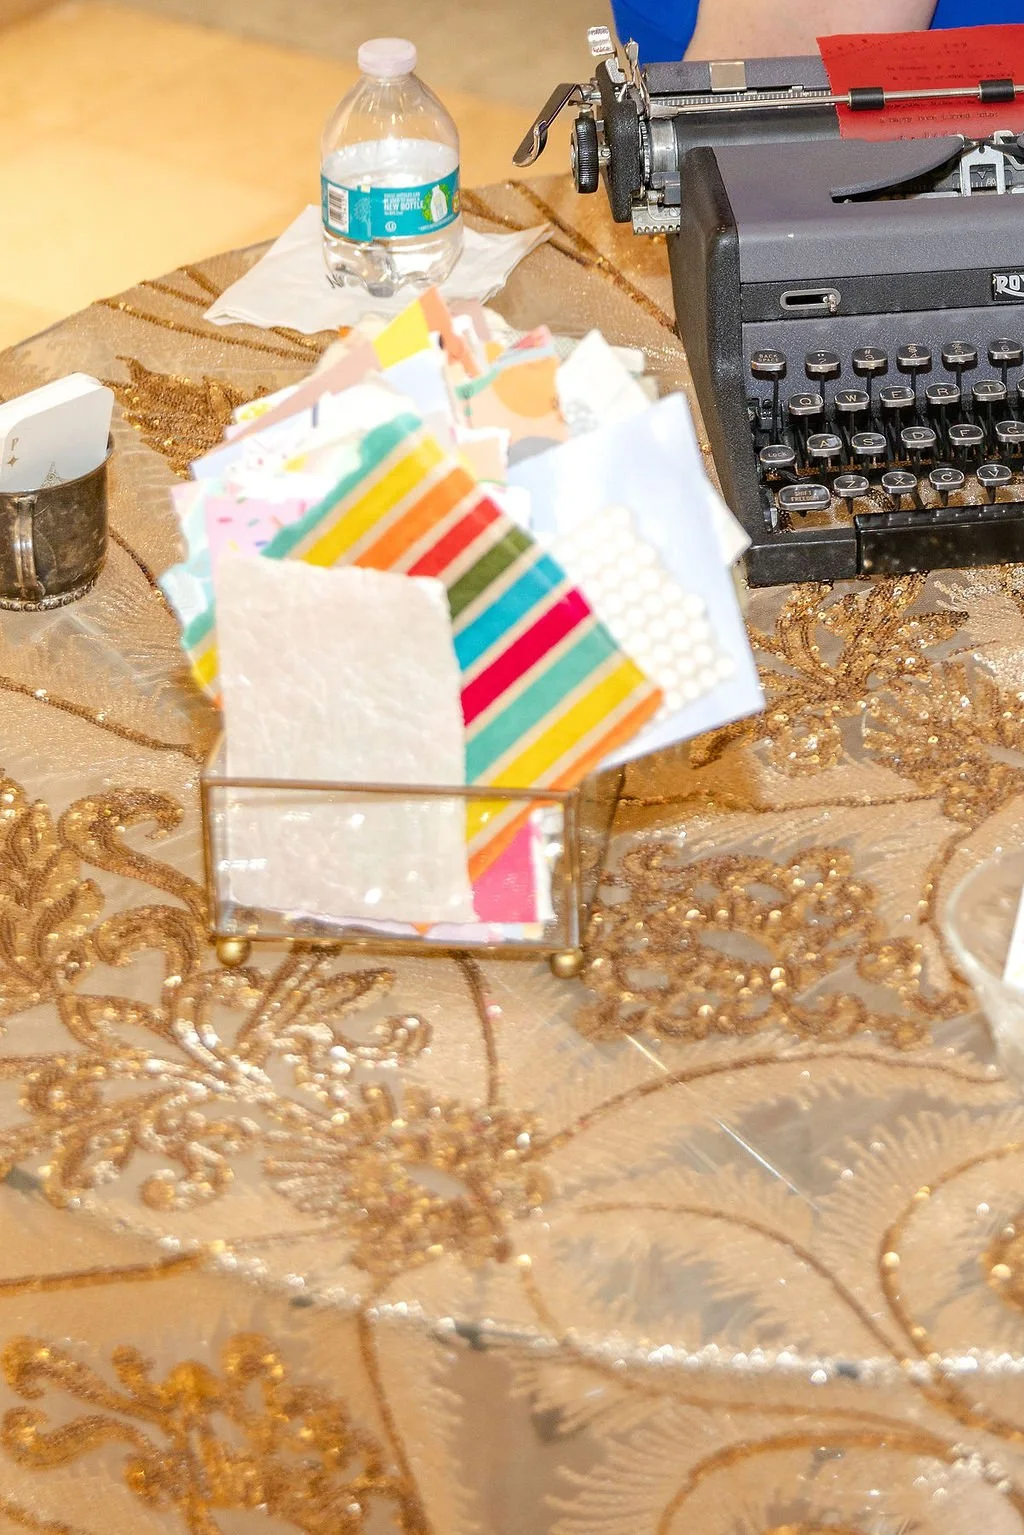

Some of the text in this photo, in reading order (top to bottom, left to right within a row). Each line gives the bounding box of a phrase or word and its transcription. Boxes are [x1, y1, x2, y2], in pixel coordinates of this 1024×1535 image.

[936, 387, 949, 396] R
[982, 384, 994, 392] T
[845, 394, 857, 402] W
[891, 390, 903, 399] E
[799, 397, 813, 406] Q
[911, 432, 925, 440] D
[959, 429, 970, 437] F
[819, 440, 829, 449] A
[862, 438, 874, 446] S
[941, 473, 954, 482] C
[988, 469, 1000, 478] V
[844, 480, 858, 489] Z
[894, 477, 906, 485] X
